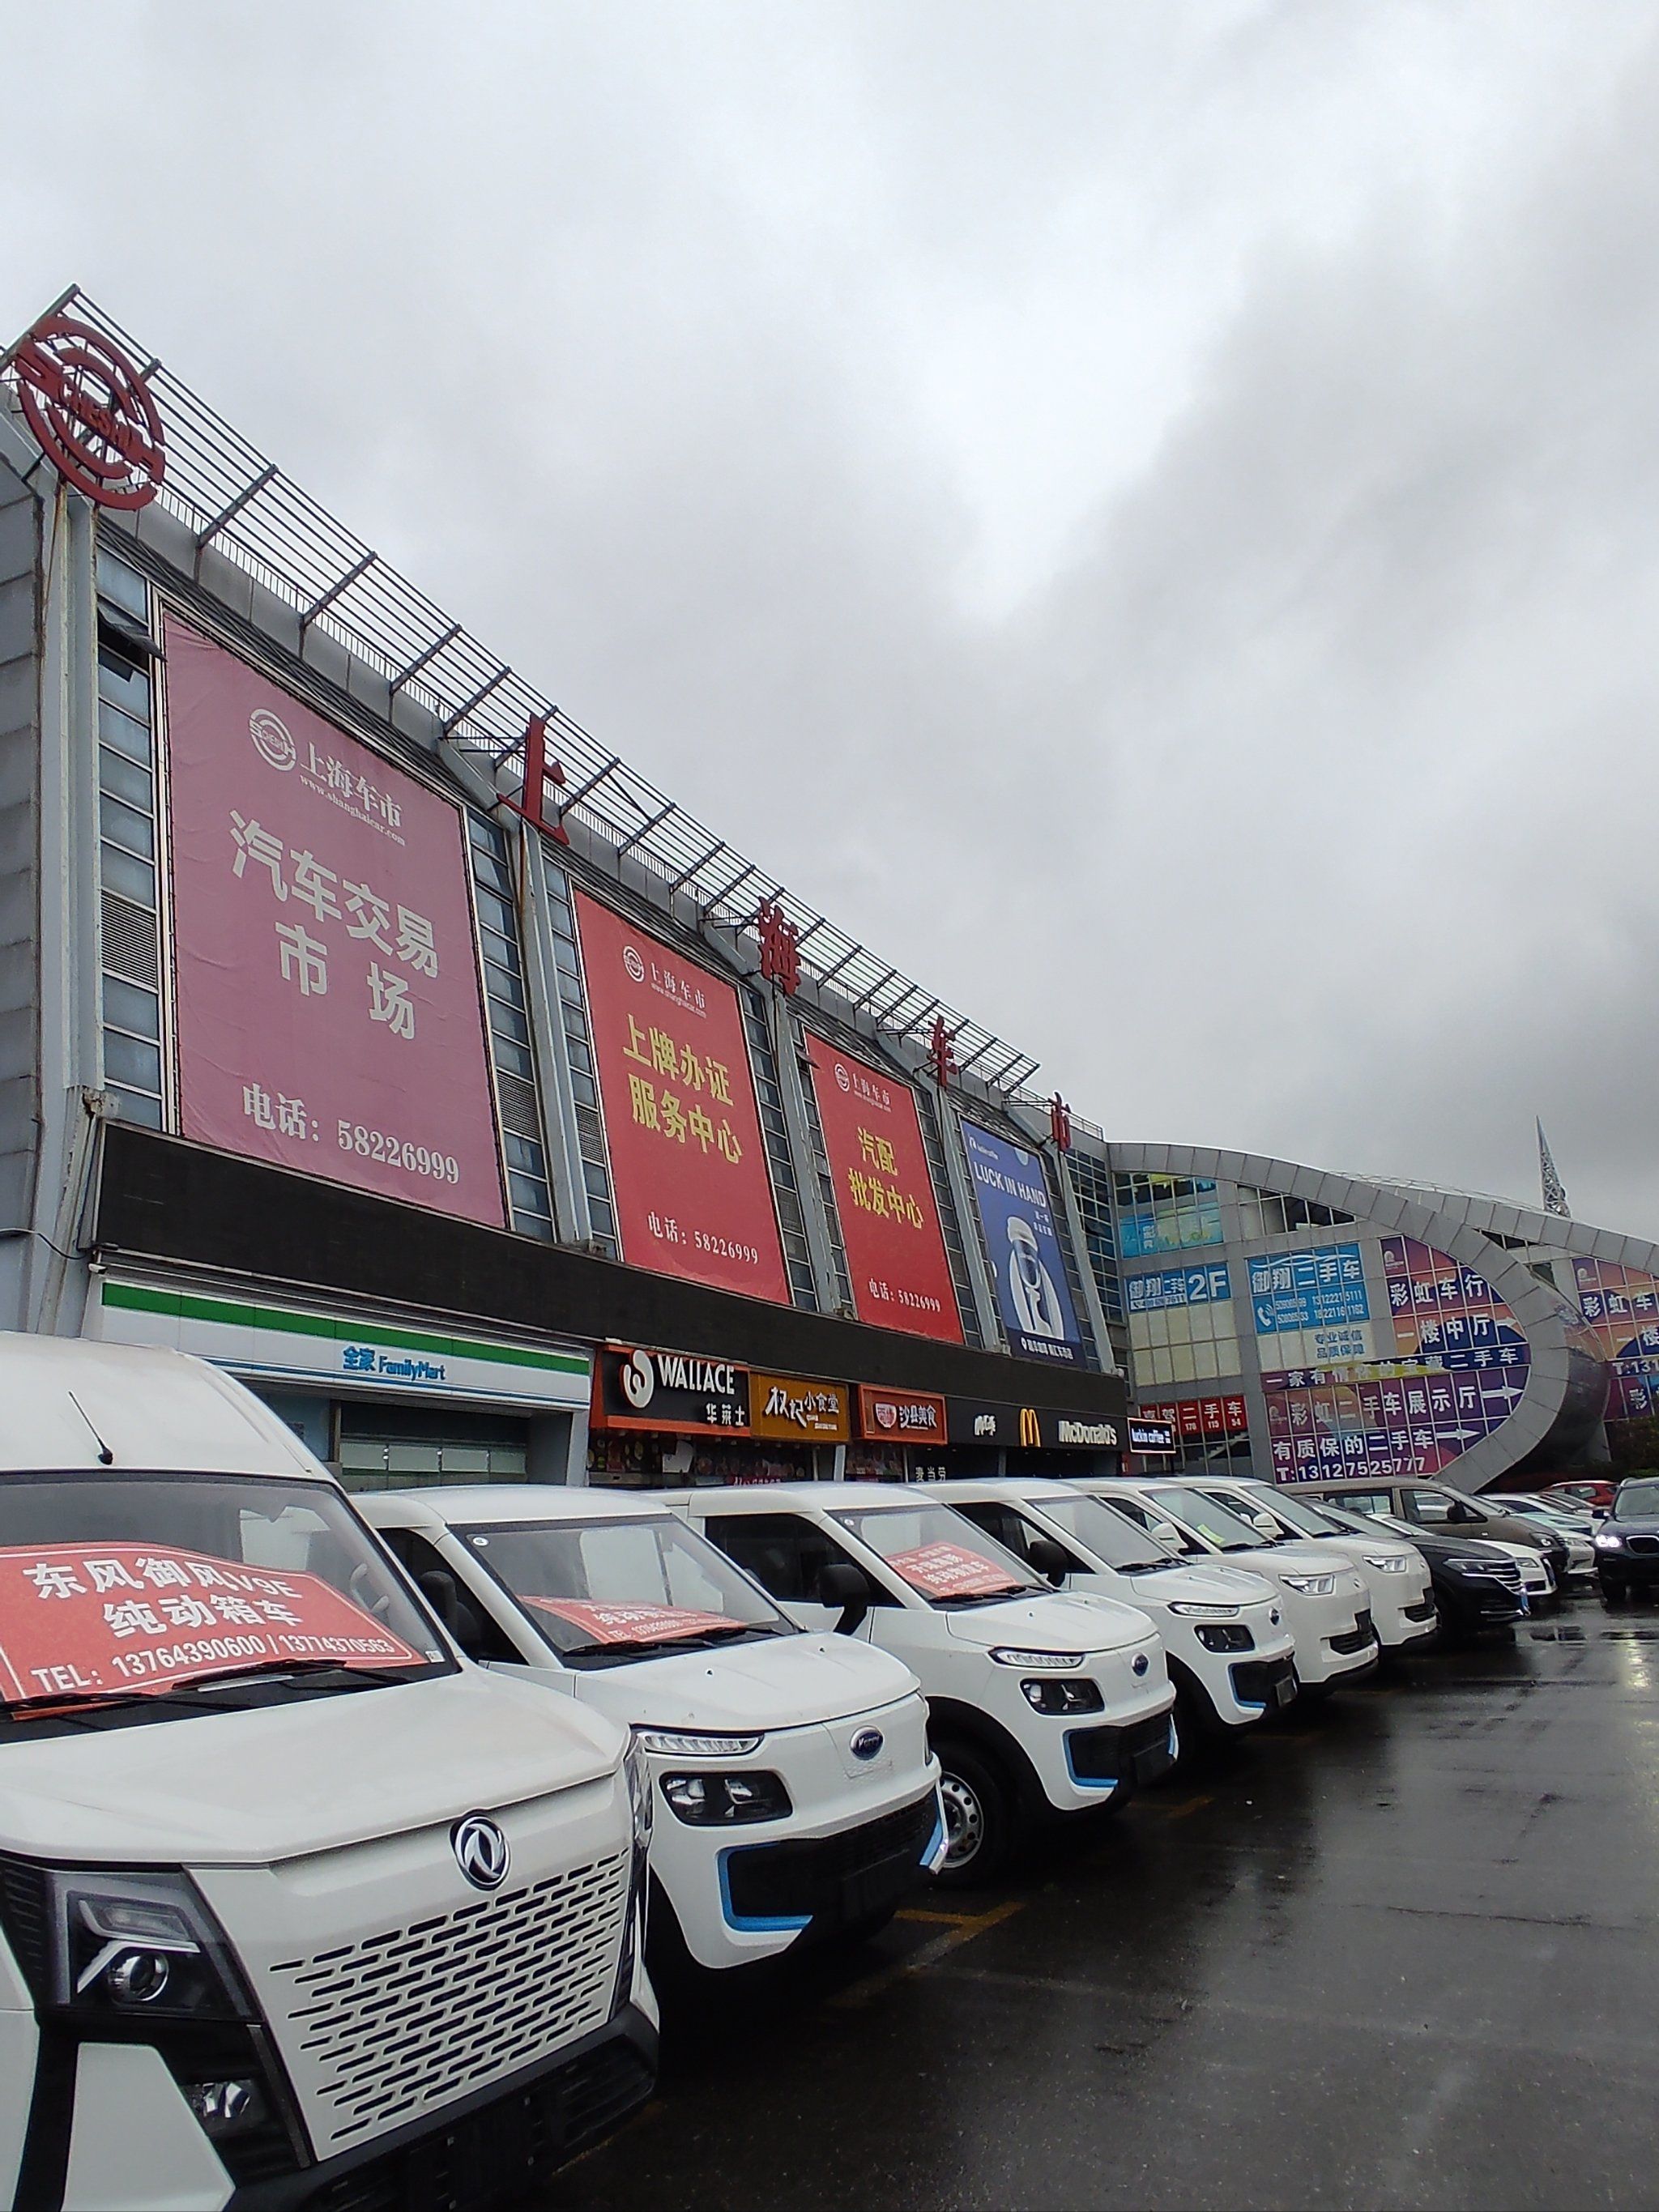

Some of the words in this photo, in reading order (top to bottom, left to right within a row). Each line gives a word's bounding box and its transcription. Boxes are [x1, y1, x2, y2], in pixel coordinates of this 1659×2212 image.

[301, 741, 403, 827] 上海车市
[229, 809, 438, 978] 汽车交易
[497, 714, 570, 845] 上
[758, 896, 800, 997] 海
[928, 1015, 958, 1087] 车
[1051, 1091, 1071, 1152] 市
[623, 1014, 733, 1106] 上牌办证
[629, 1073, 742, 1165] 服务中心
[857, 1127, 898, 1175] 汽配
[848, 1167, 925, 1230] 批发中心
[974, 1161, 1004, 1191] LUCK
[1004, 1176, 1017, 1196] IN
[1017, 1182, 1046, 1208] HAND
[1188, 1270, 1226, 1300] 2F
[1389, 1274, 1483, 1306] 彩虹车行
[1582, 1290, 1656, 1317] 彩虹车
[1315, 1329, 1363, 1345] 专业诚信
[1397, 1313, 1491, 1345] 一楼中厅
[343, 1345, 376, 1370] 全家
[379, 1355, 446, 1381] FamilyMart
[657, 1353, 736, 1395] WALLACE
[706, 1402, 745, 1426] 华莱士
[899, 1404, 937, 1428] 沙县美食
[1291, 1386, 1476, 1426] 彩虹二手车展示厅
[1058, 1421, 1116, 1445] McDonald's
[1273, 1429, 1435, 1460] 有质保的二手车
[112, 1634, 266, 1677] 13764390600
